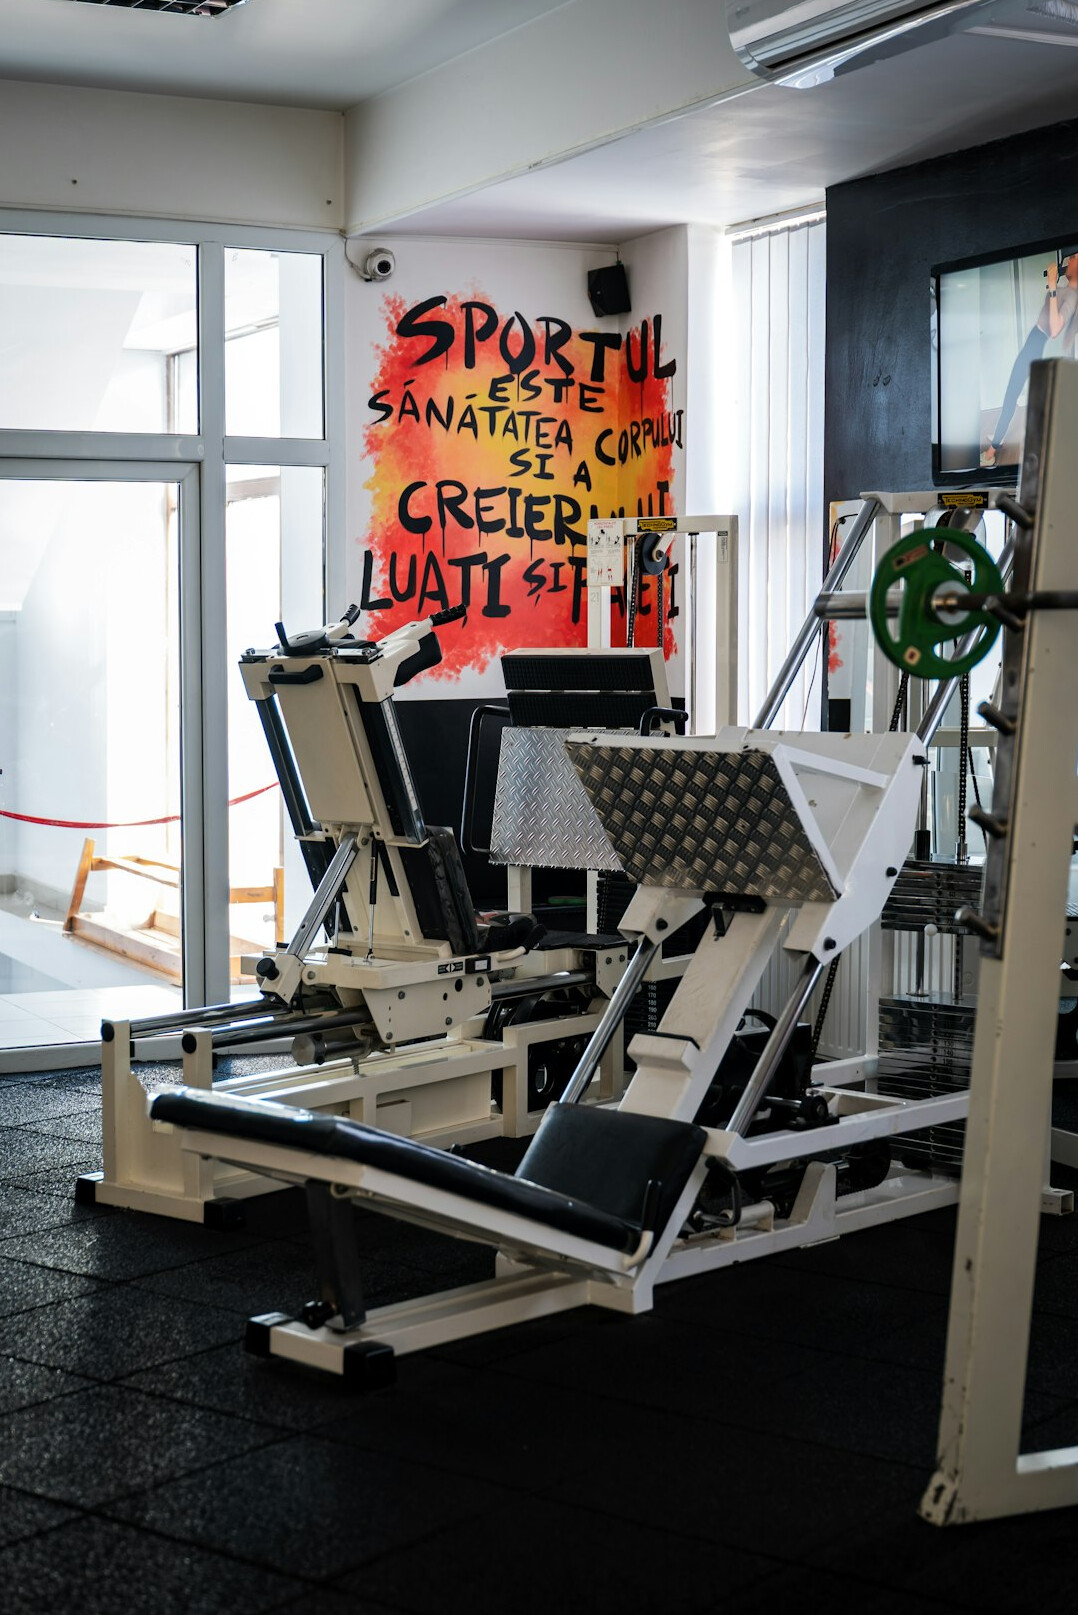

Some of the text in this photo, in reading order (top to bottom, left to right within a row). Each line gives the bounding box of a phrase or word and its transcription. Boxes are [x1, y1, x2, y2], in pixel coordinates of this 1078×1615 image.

[396, 296, 676, 383] SPORTUL
[489, 369, 605, 412] ESTE
[595, 410, 684, 466] CORPULUI
[510, 448, 592, 492] SI A
[399, 480, 669, 547] CREIERI
